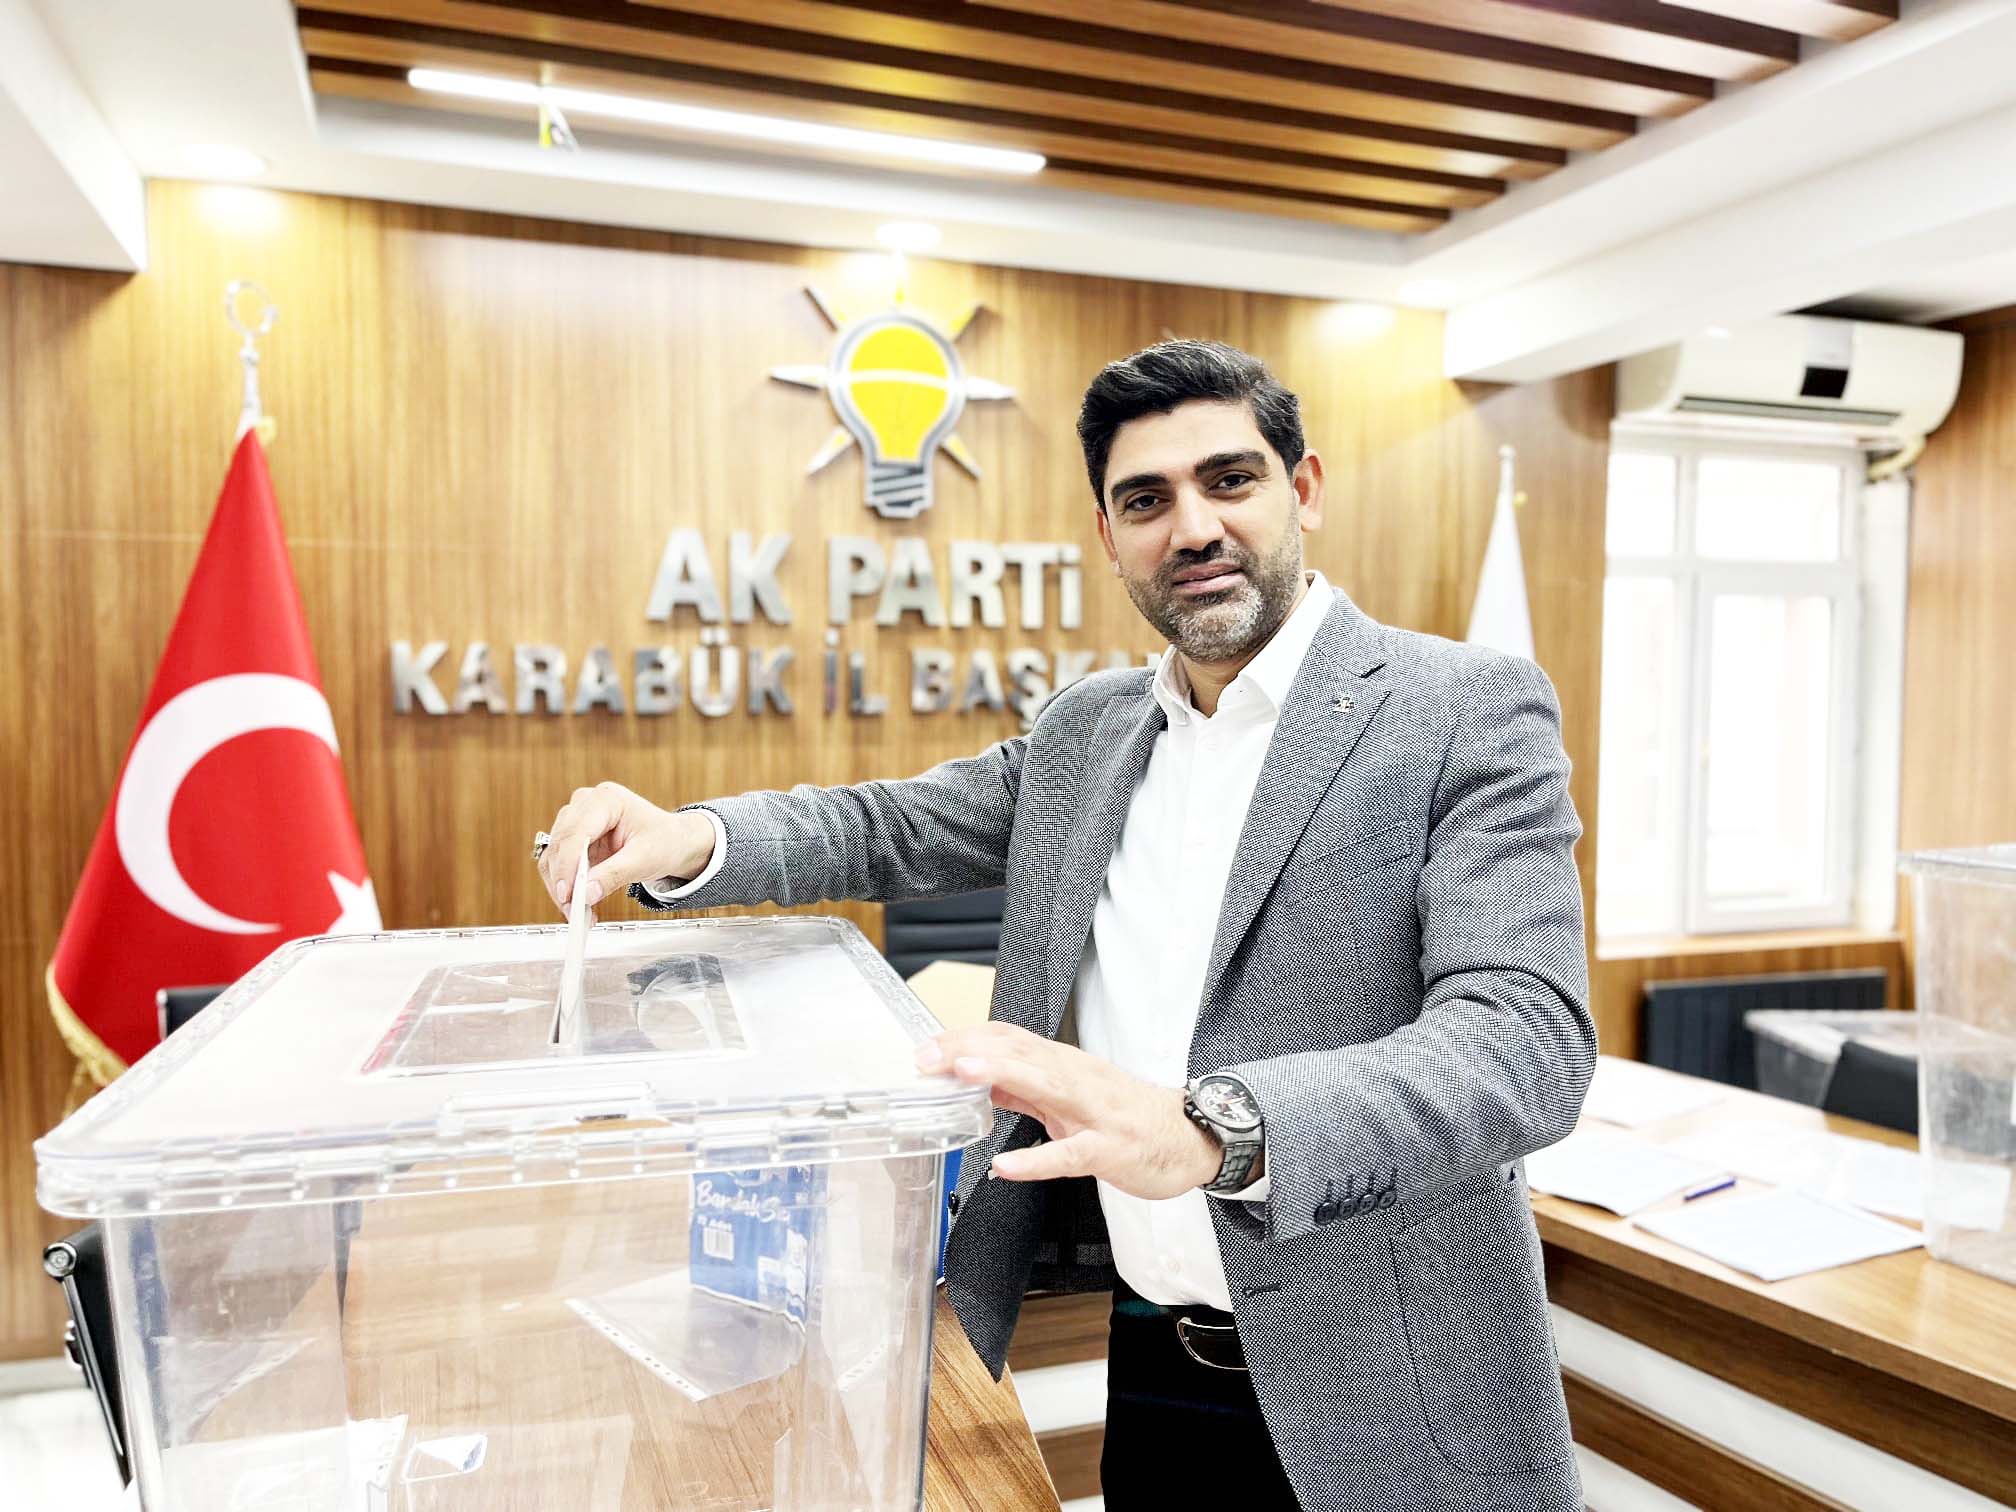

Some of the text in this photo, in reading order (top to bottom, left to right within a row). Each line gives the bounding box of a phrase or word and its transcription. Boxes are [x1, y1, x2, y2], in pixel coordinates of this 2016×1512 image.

[645, 528, 793, 624] AK
[390, 627, 795, 717] KARABÜK
[824, 629, 886, 716] İL
